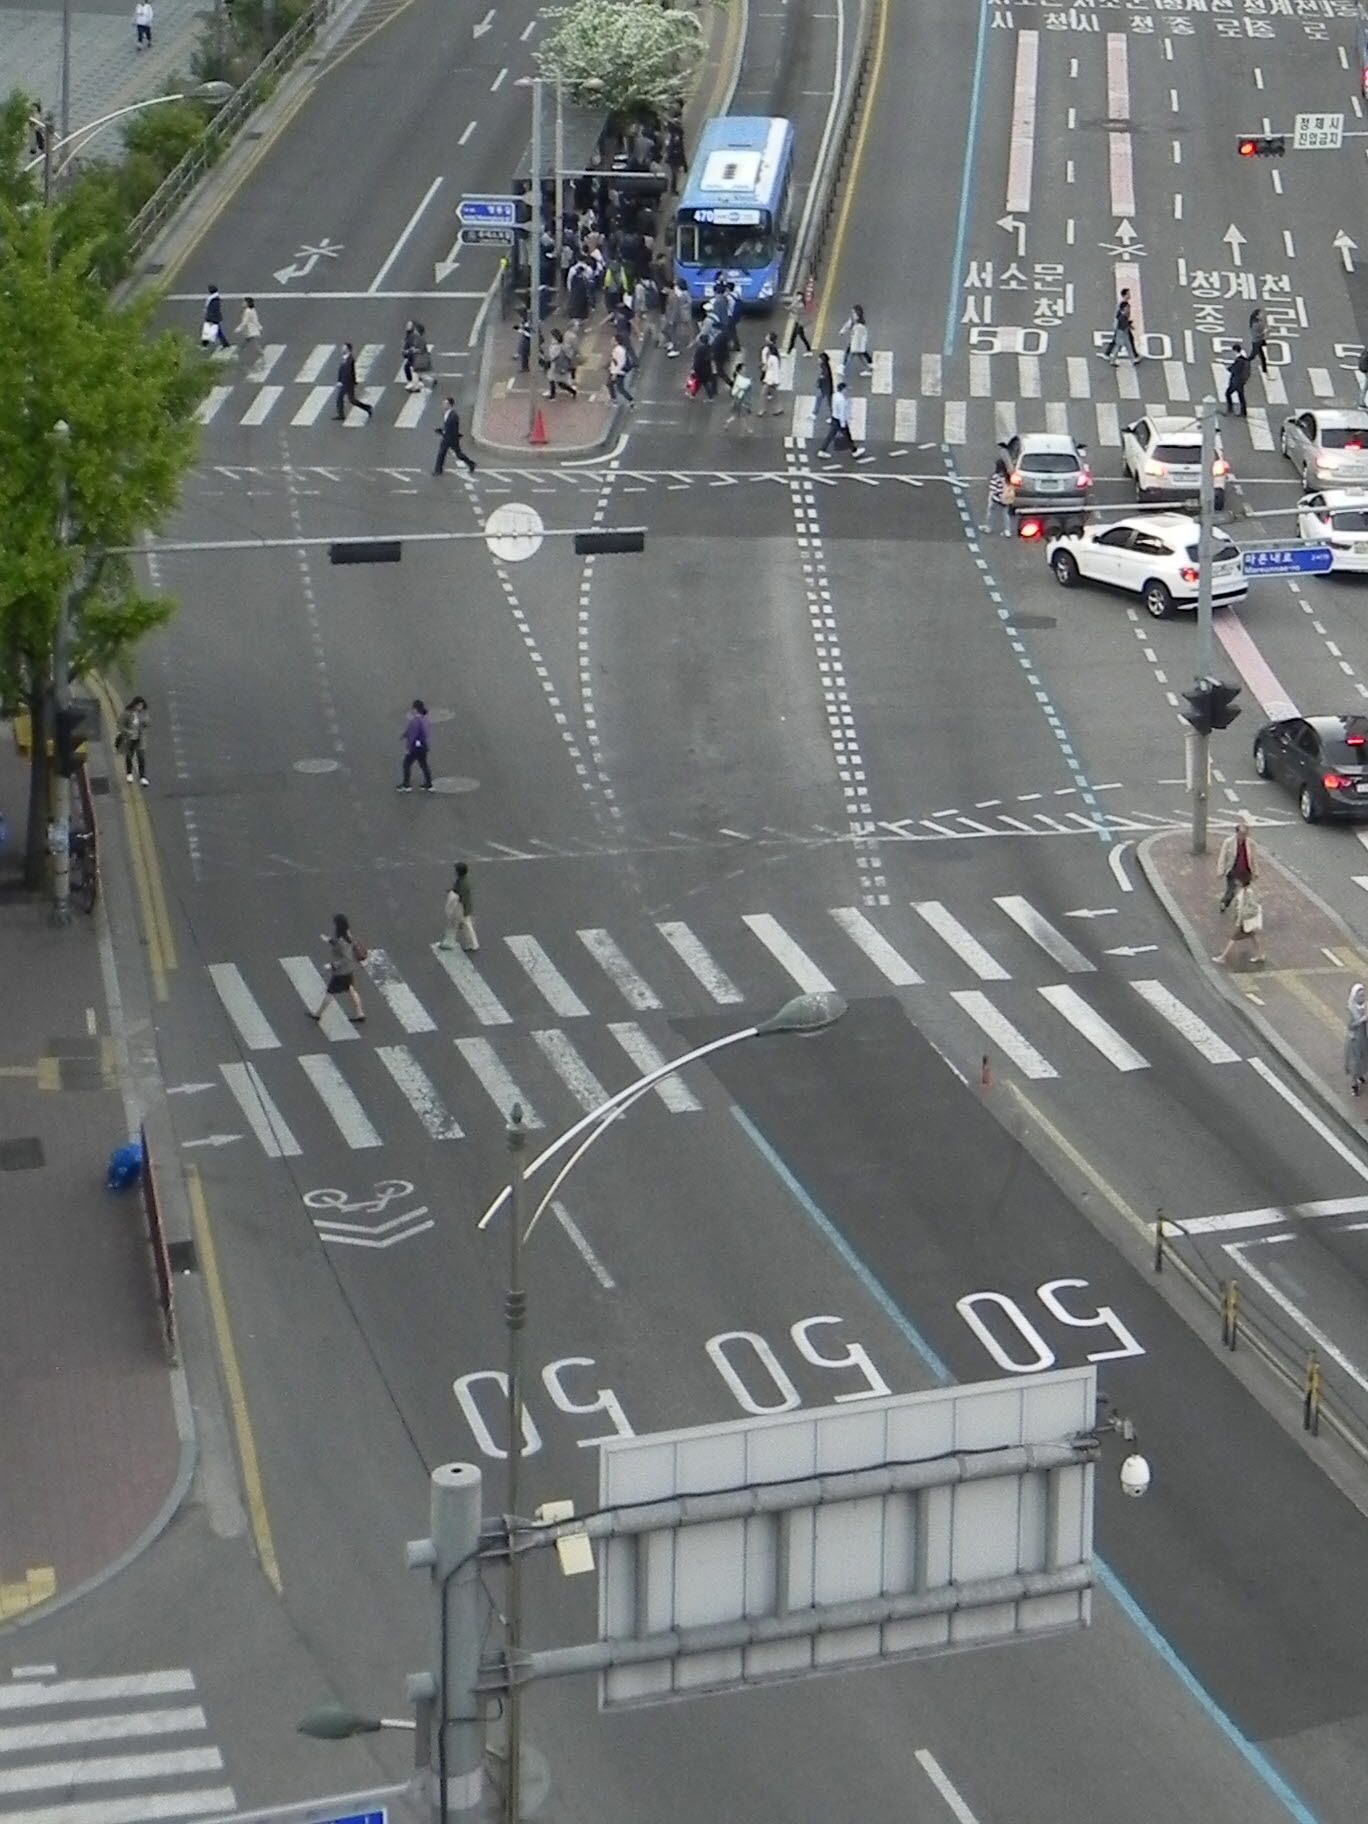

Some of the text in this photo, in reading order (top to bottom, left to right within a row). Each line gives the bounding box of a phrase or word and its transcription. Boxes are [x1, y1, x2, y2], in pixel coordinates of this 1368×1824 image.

[1298, 132, 1338, 146] 진입금지
[693, 210, 715, 223] 470
[964, 262, 1064, 292] 서소문
[1190, 270, 1293, 302] 청계천
[969, 327, 1049, 357] 50
[1212, 336, 1293, 366] 50
[1244, 552, 1293, 565] 마른내로
[955, 1277, 1146, 1373] 50
[705, 1314, 893, 1416] 50
[452, 1356, 637, 1460] 50
